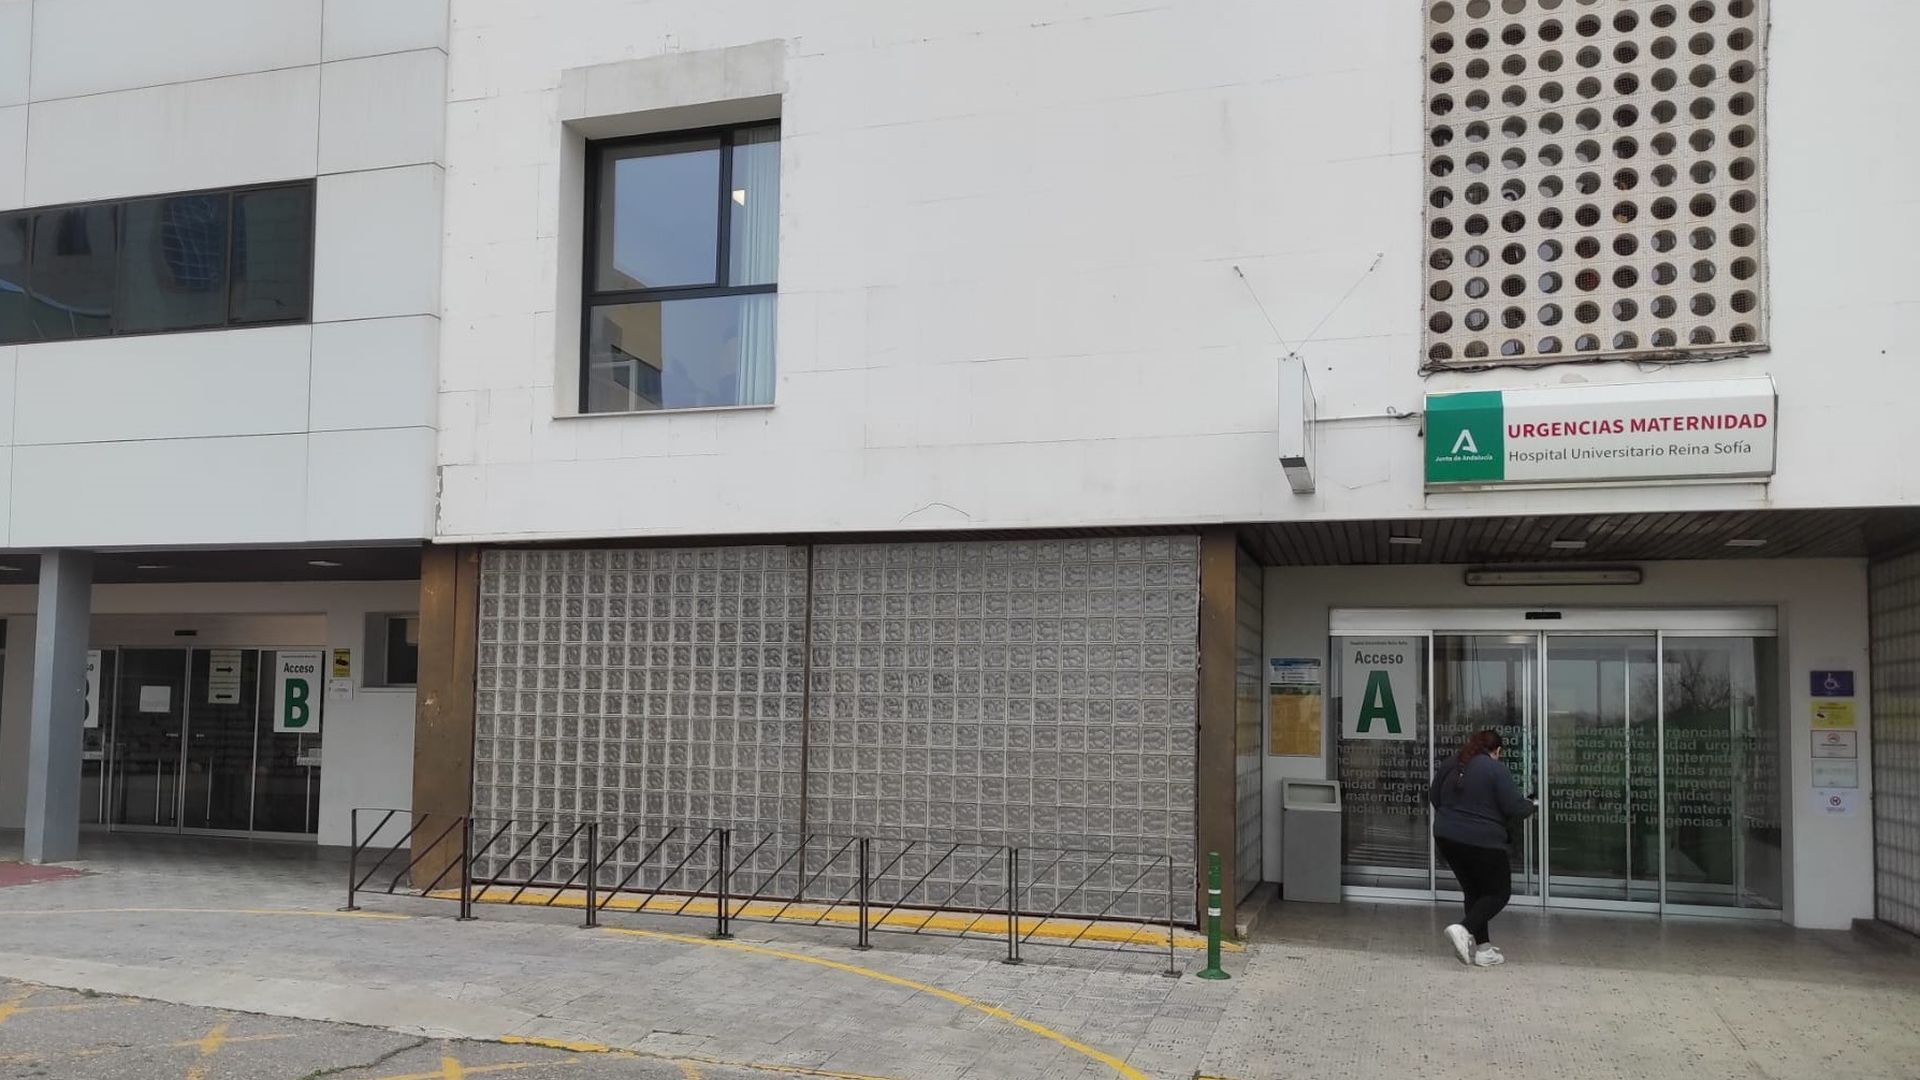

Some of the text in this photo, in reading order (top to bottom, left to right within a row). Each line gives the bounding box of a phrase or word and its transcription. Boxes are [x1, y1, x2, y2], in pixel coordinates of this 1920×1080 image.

[1508, 413, 1767, 438] URGENCIAS MATERNIDAD
[1509, 440, 1752, 463] Hospital Universitario Reina Sofía
[283, 662, 315, 673] Acceso
[1354, 650, 1404, 665] Acceso
[284, 677, 310, 728] B
[1355, 669, 1402, 734] A
